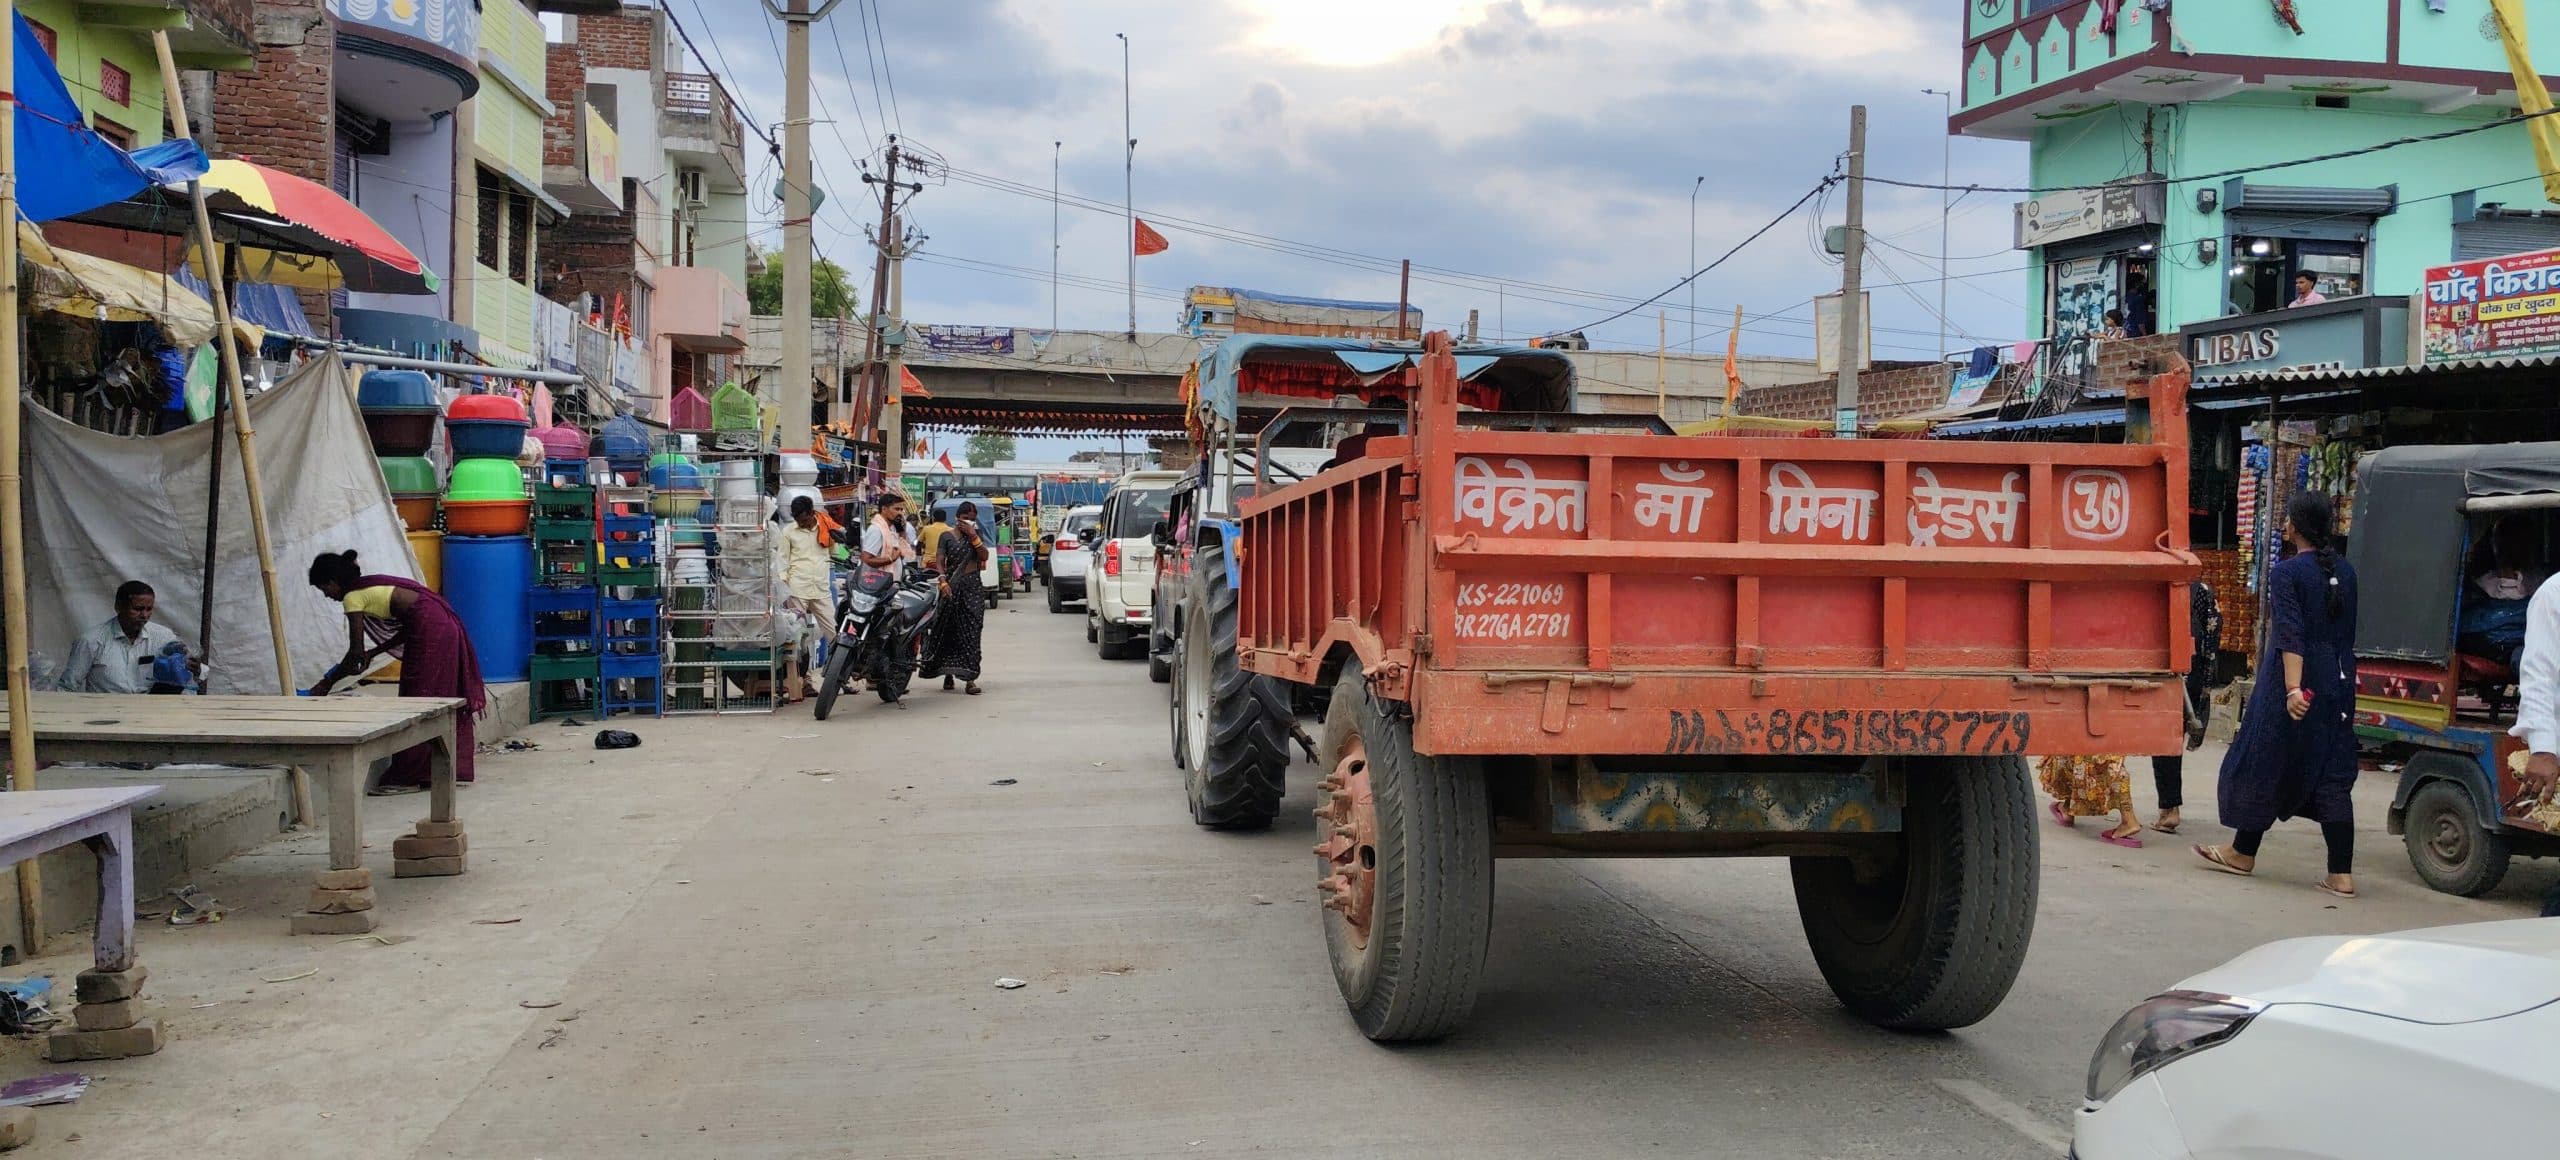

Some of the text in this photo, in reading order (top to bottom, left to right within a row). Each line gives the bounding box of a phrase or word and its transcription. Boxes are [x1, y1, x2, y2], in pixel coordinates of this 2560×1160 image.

[2428, 268, 2479, 303] चाँद
[2525, 298, 2556, 313] खुदरा
[2194, 328, 2279, 367] LIBAS
[1634, 460, 1713, 534] माँ
[1767, 462, 1879, 541] मिना
[1907, 466, 2026, 547] ट्रेडर्स
[2073, 481, 2121, 530] 36
[1456, 583, 1564, 606] KS-221069
